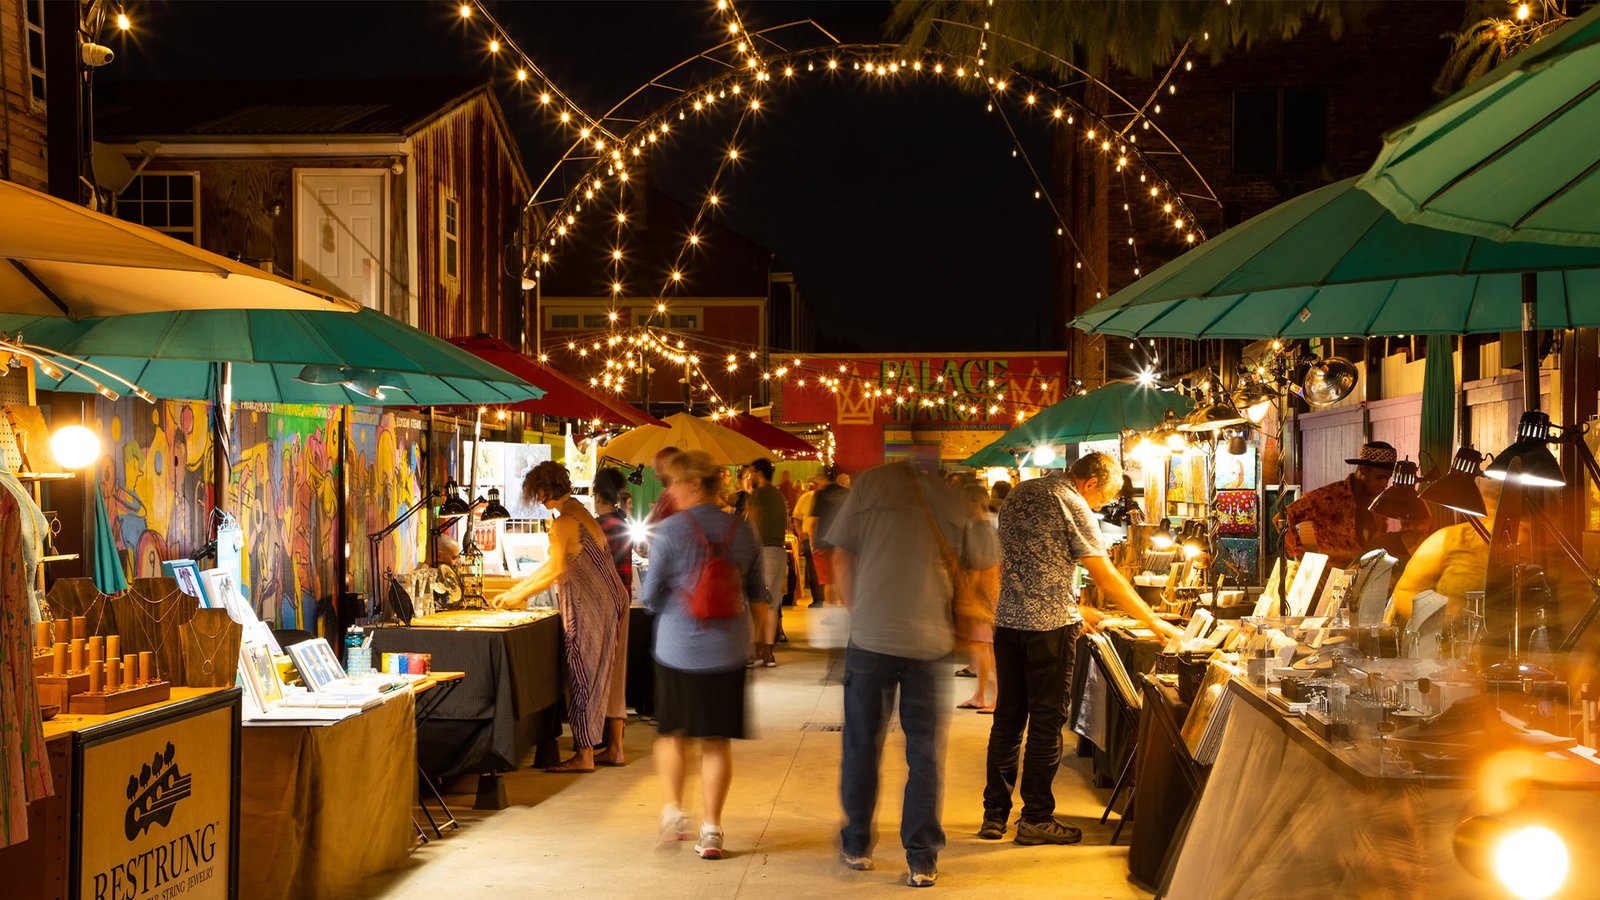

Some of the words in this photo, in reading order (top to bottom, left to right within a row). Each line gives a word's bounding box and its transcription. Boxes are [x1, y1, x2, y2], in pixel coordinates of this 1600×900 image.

[881, 359, 1008, 395] PALACE
[162, 880, 186, 900] STRING
[186, 865, 214, 893] JEWELRY
